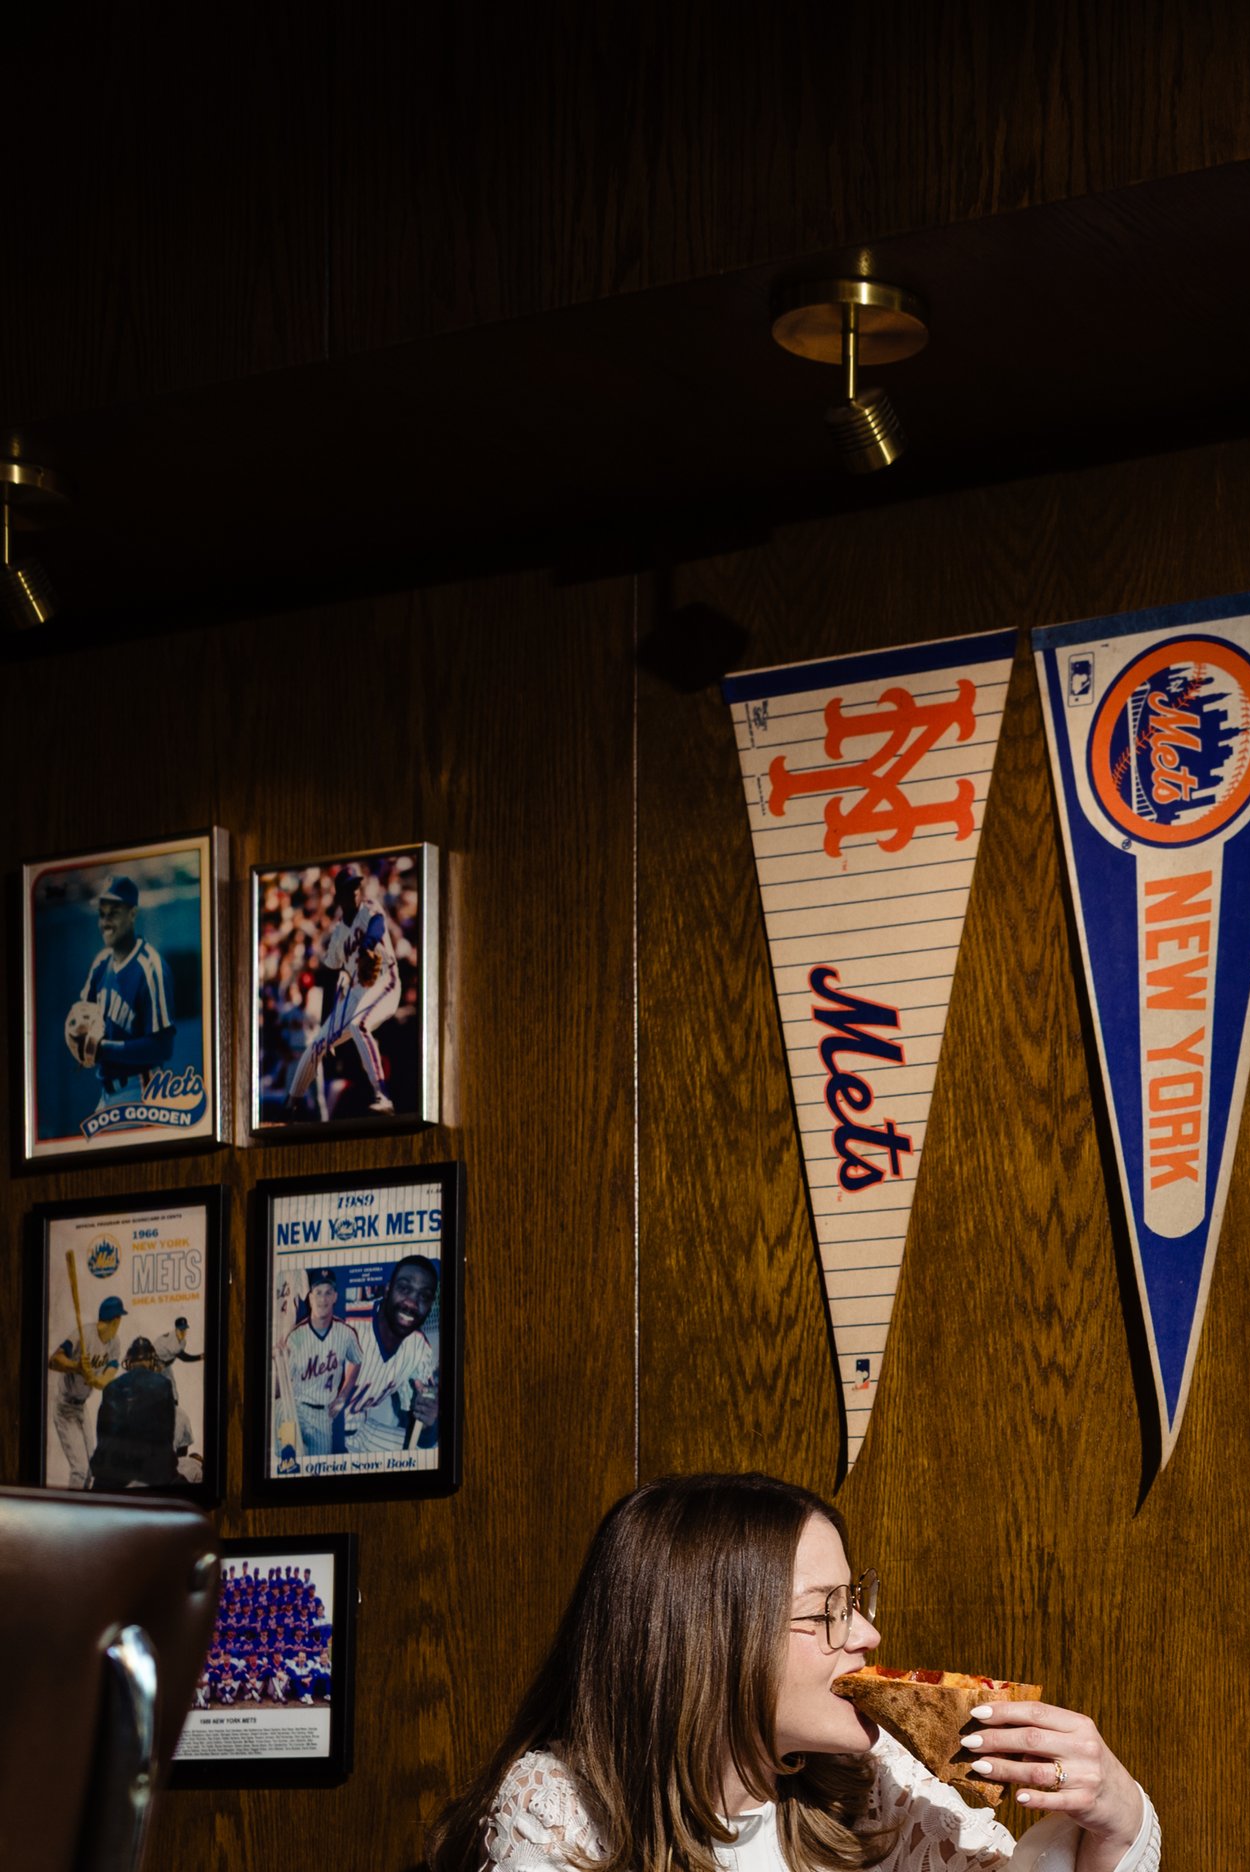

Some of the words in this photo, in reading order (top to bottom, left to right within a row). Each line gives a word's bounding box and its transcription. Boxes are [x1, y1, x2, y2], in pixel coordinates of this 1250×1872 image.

[1147, 690, 1202, 805] Mets
[1144, 870, 1212, 1011] NEW
[143, 1066, 203, 1101] Mets
[808, 964, 913, 1193] Mets
[87, 1108, 120, 1133] DOC
[125, 1107, 192, 1125] GOODEN
[1147, 1026, 1205, 1190] YORK
[337, 1194, 374, 1209] 1989
[132, 1229, 159, 1240] 1966
[277, 1220, 322, 1246] NEW
[386, 1209, 441, 1235] METS
[132, 1241, 157, 1251] NEW
[159, 1238, 190, 1249] YORK
[132, 1249, 202, 1295] METS
[158, 1292, 200, 1304] STADIUM
[301, 1349, 338, 1381] Mets
[325, 1375, 334, 1393] 4
[305, 1461, 347, 1476] Official
[351, 1460, 383, 1471] Score
[386, 1457, 417, 1469] Book
